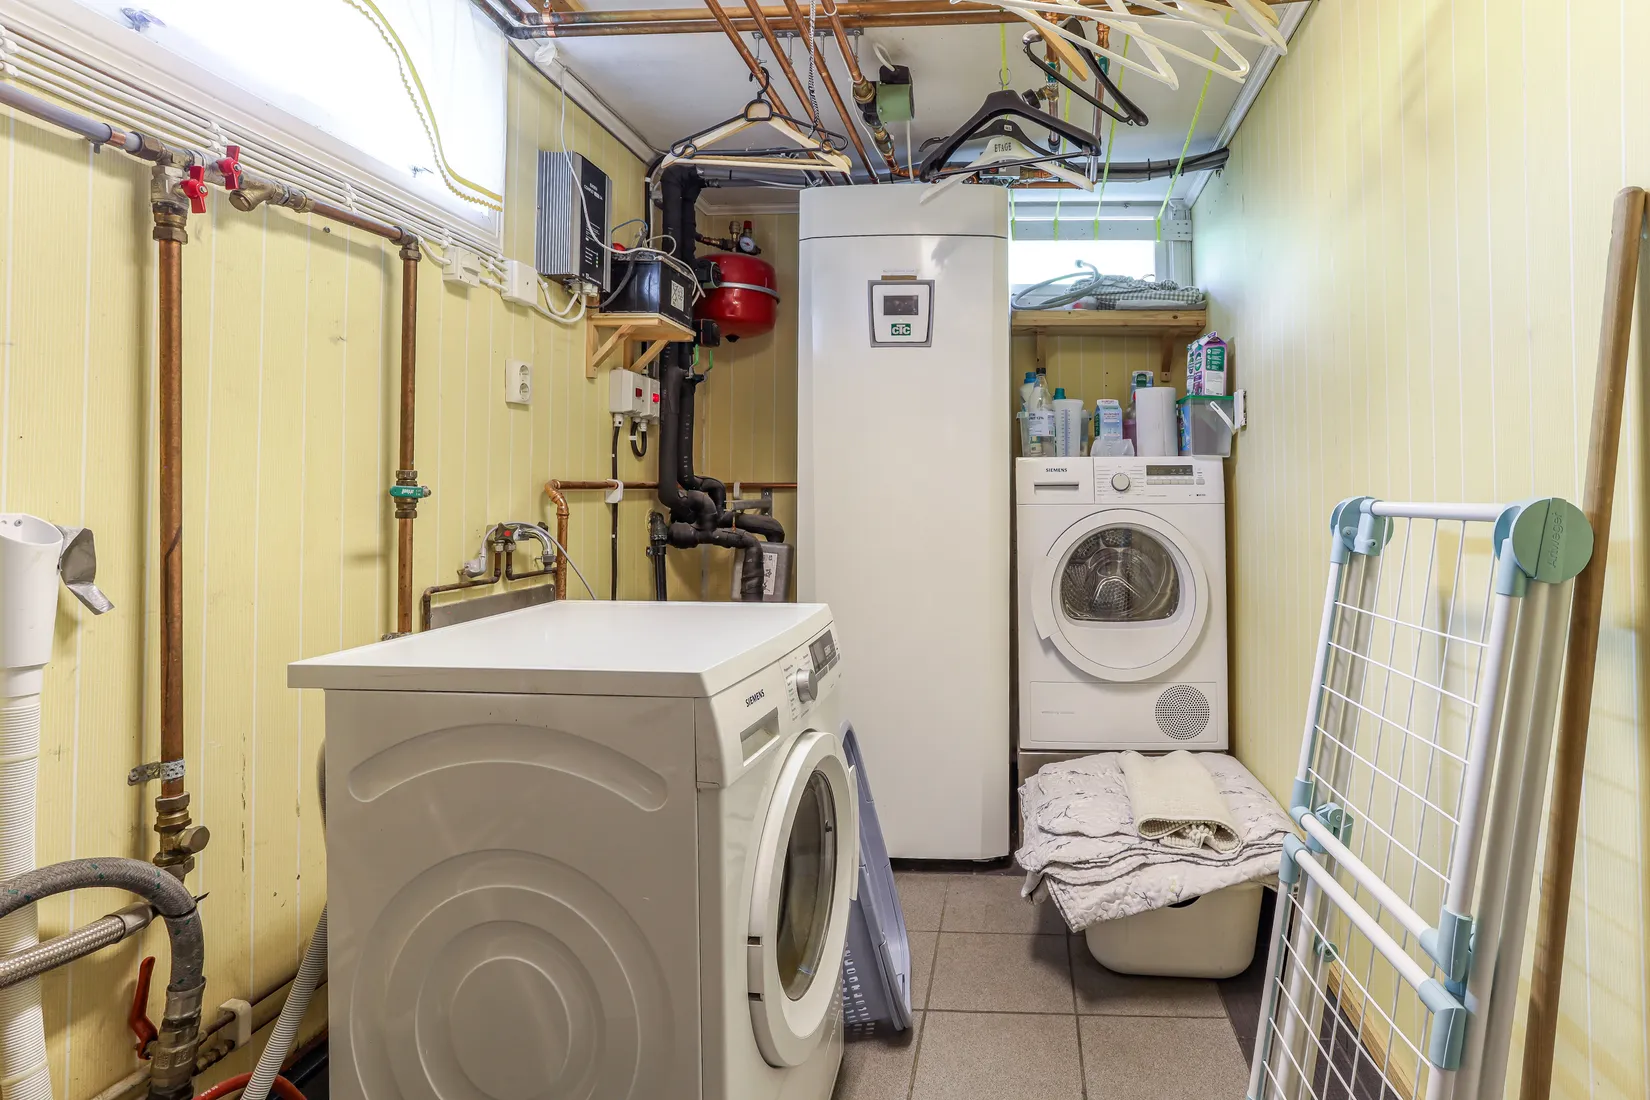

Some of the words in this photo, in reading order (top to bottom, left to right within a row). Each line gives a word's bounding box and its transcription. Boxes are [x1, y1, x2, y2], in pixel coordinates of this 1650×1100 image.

[994, 142, 1012, 153] ETAGE
[892, 324, 911, 335] CTC
[745, 689, 765, 708] SIEMENS
